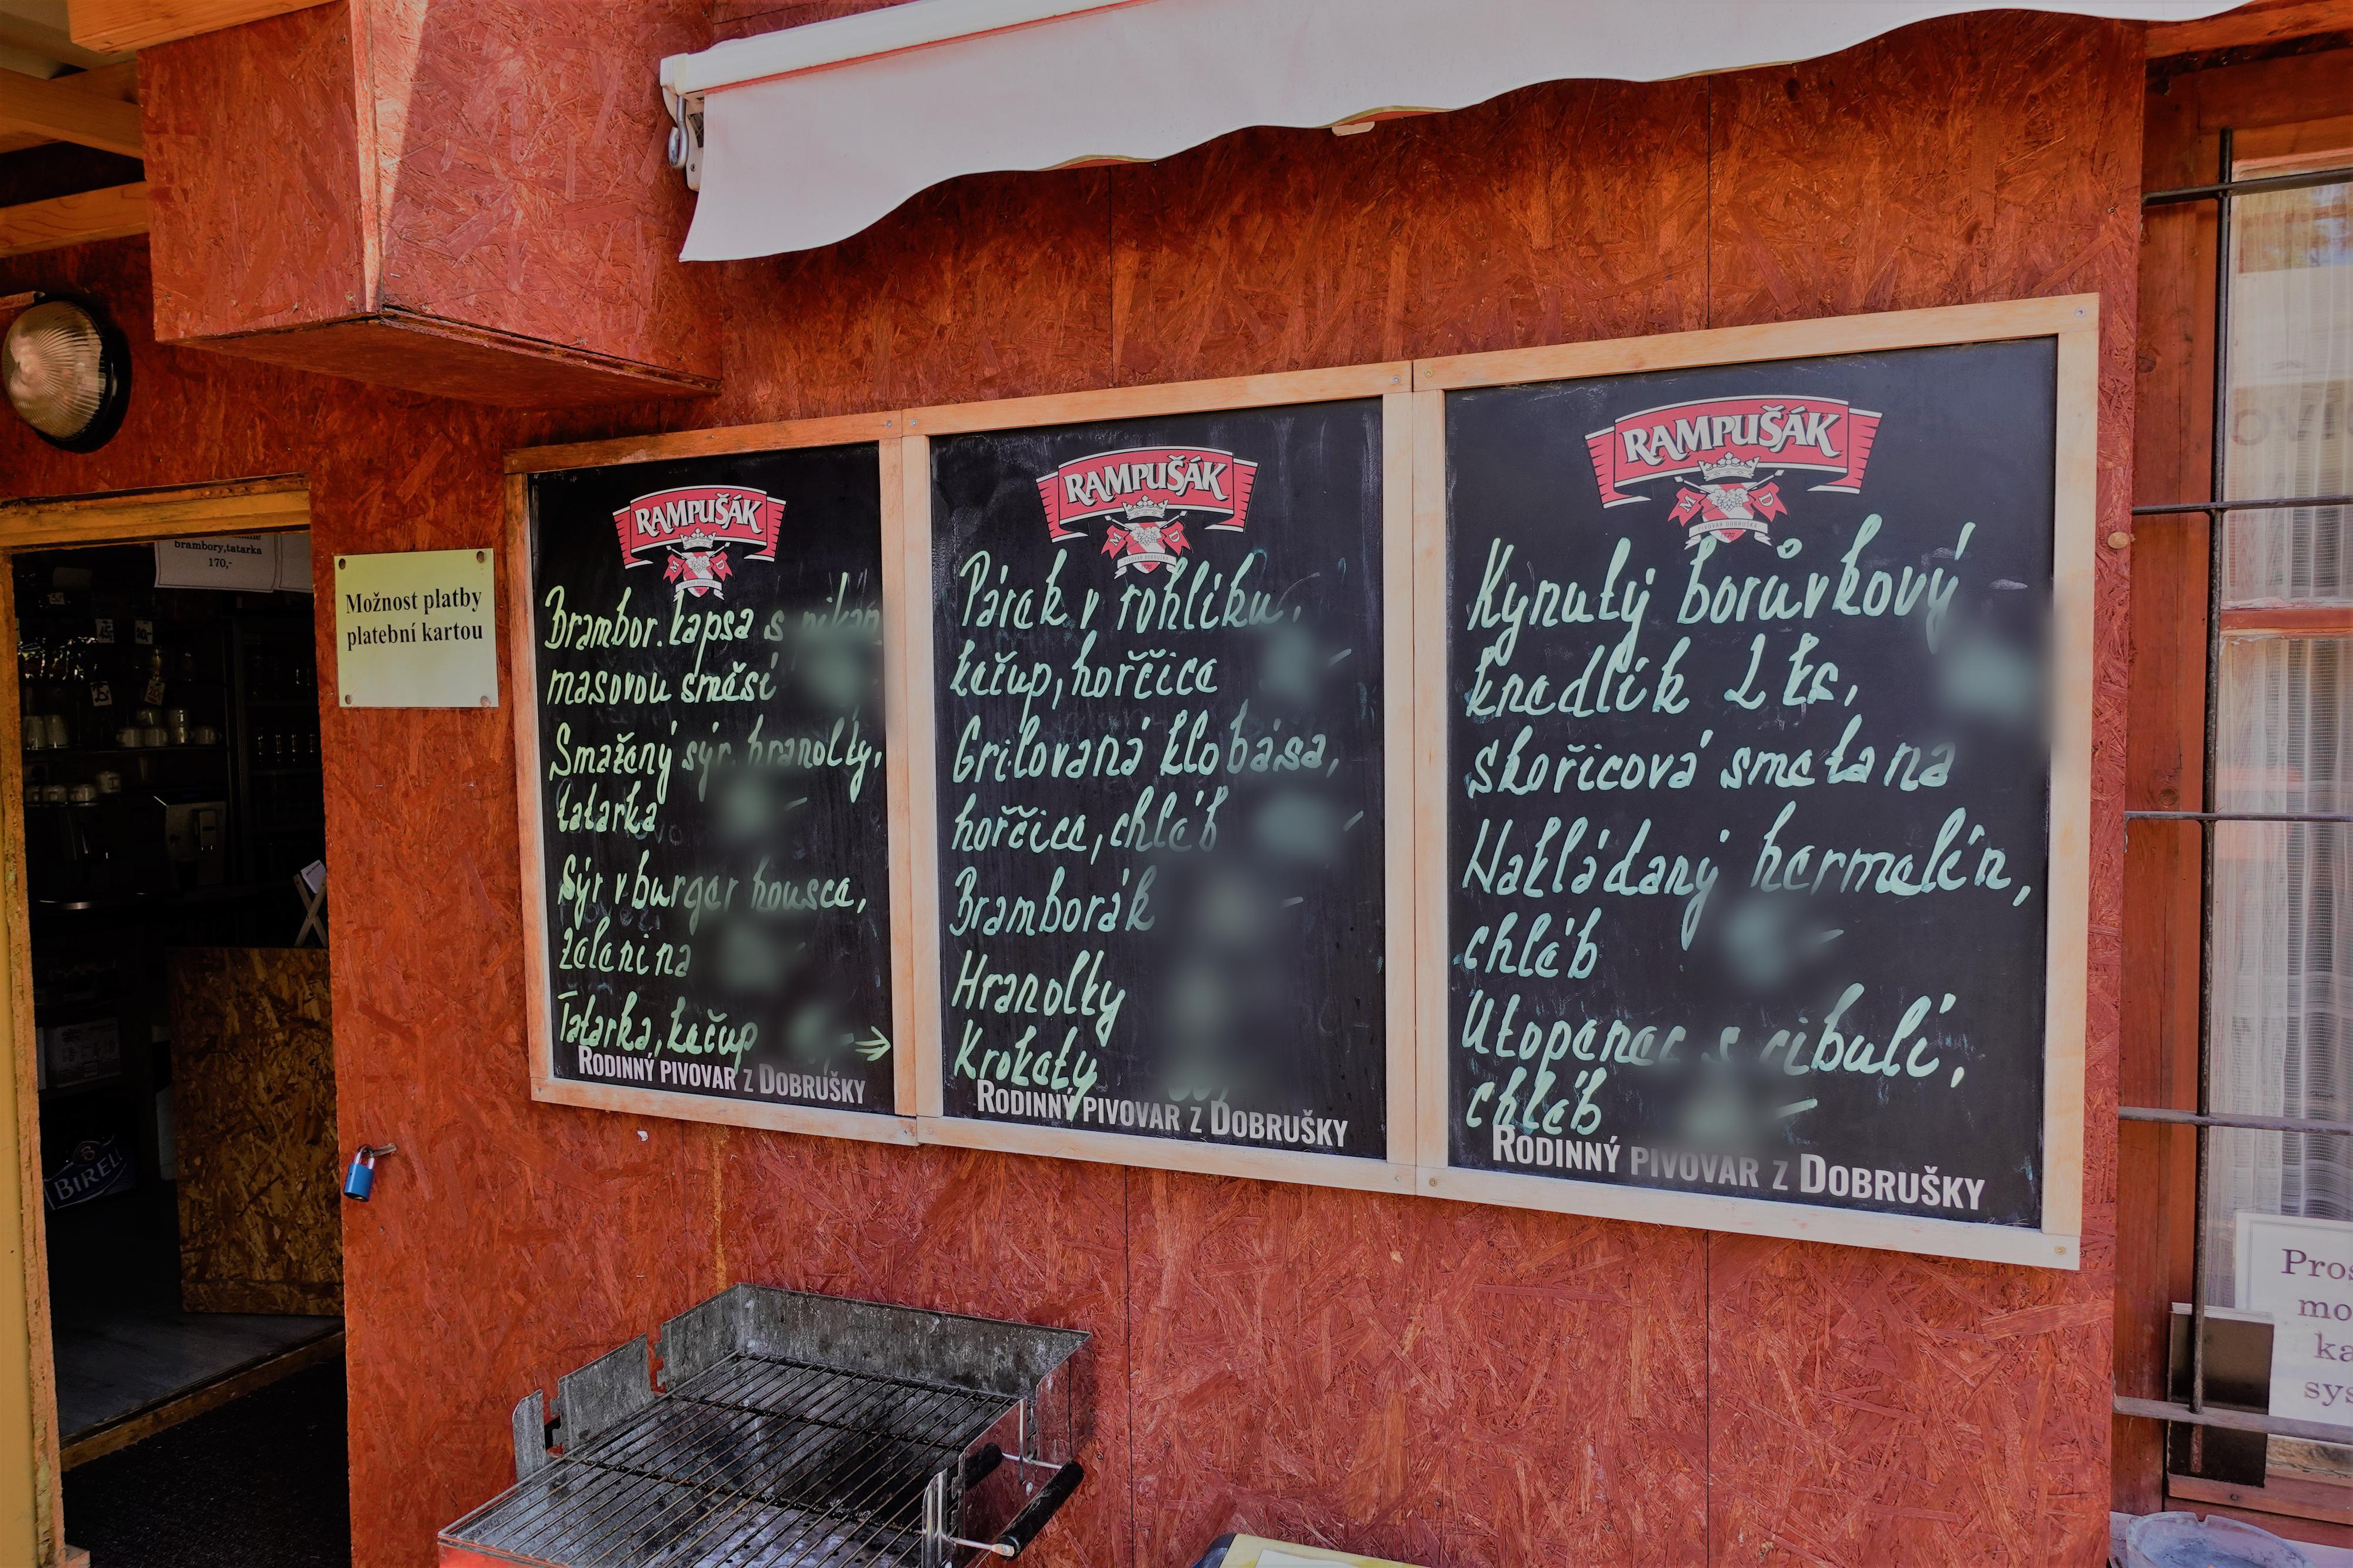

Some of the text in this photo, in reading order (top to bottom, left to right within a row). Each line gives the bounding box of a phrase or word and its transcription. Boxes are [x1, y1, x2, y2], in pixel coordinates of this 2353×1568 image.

[1623, 403, 1843, 466] RAMPUŠÁK
[1065, 455, 1228, 506] RAMPUŠÁK
[1679, 494, 1697, 513] M
[1758, 492, 1774, 506] D
[634, 492, 764, 536] RAMPUŠÁK
[1108, 531, 1122, 547] M
[1168, 529, 1181, 542] D
[1698, 522, 1723, 532] PIVOVAR
[208, 558, 232, 569] 170,-
[669, 559, 681, 573] M
[959, 548, 1068, 629] Párek
[1079, 588, 1099, 630] v
[1677, 513, 1977, 655] borůvkový
[345, 587, 484, 620] Možnost platby
[346, 619, 484, 652] platební kartou
[547, 669, 672, 705] masovou
[681, 652, 778, 703] směsí
[549, 720, 678, 805] Smažený
[952, 714, 1151, 783] Grilovaná
[556, 780, 658, 834] tatarka
[557, 853, 603, 930] Sýr
[949, 865, 1158, 936] Bramborák
[1464, 908, 1602, 979] chléb
[952, 950, 1126, 1047] Hranolky
[953, 1019, 1098, 1122] Krokety
[1465, 1066, 1607, 1135] chléb
